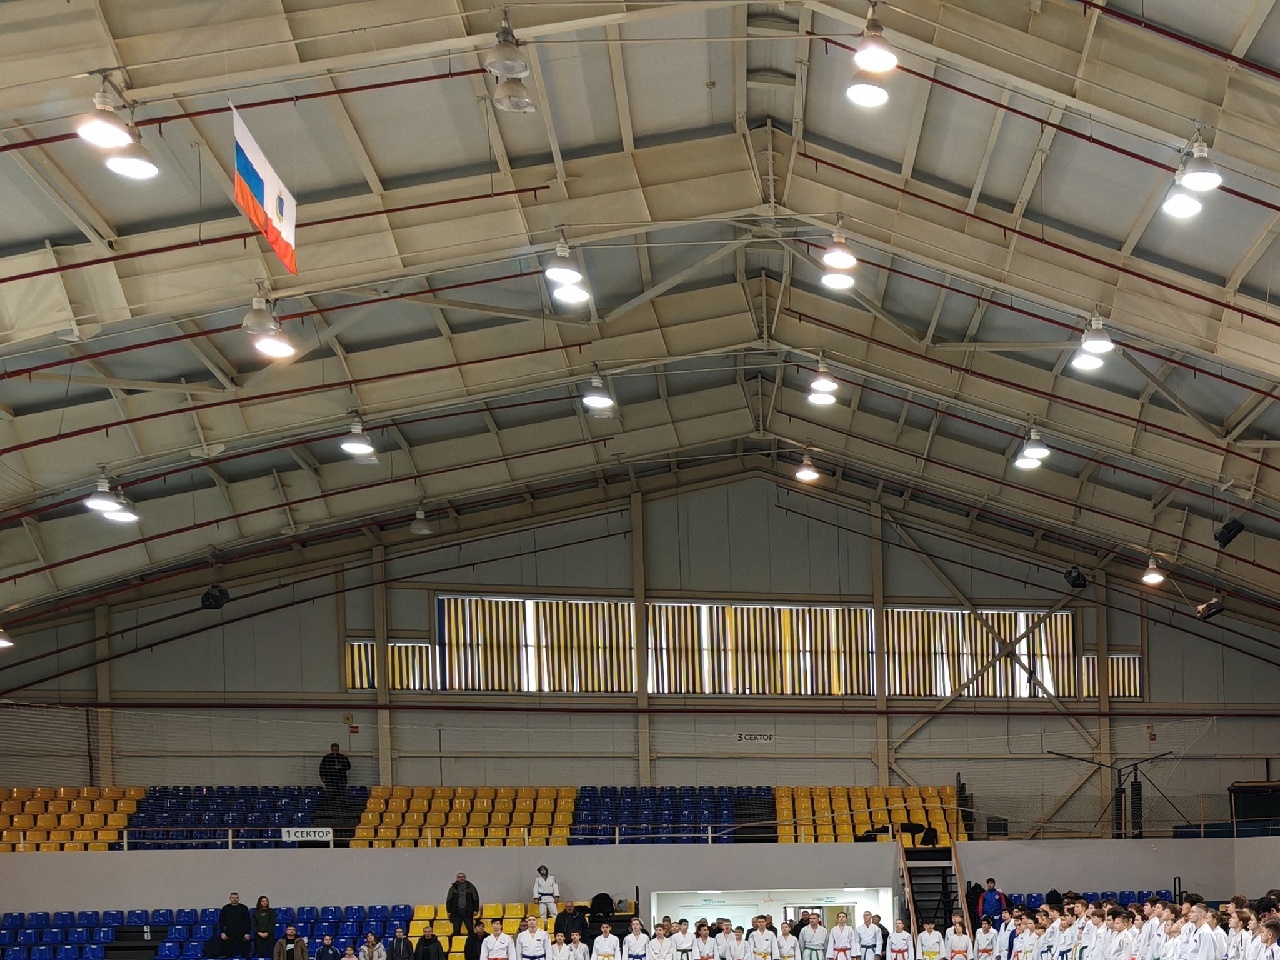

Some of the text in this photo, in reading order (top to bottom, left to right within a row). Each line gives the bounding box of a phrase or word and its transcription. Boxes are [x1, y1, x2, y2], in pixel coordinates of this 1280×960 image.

[737, 733, 773, 741] 3 СЕКТОР
[286, 830, 331, 838] 1 СЕКТОР
